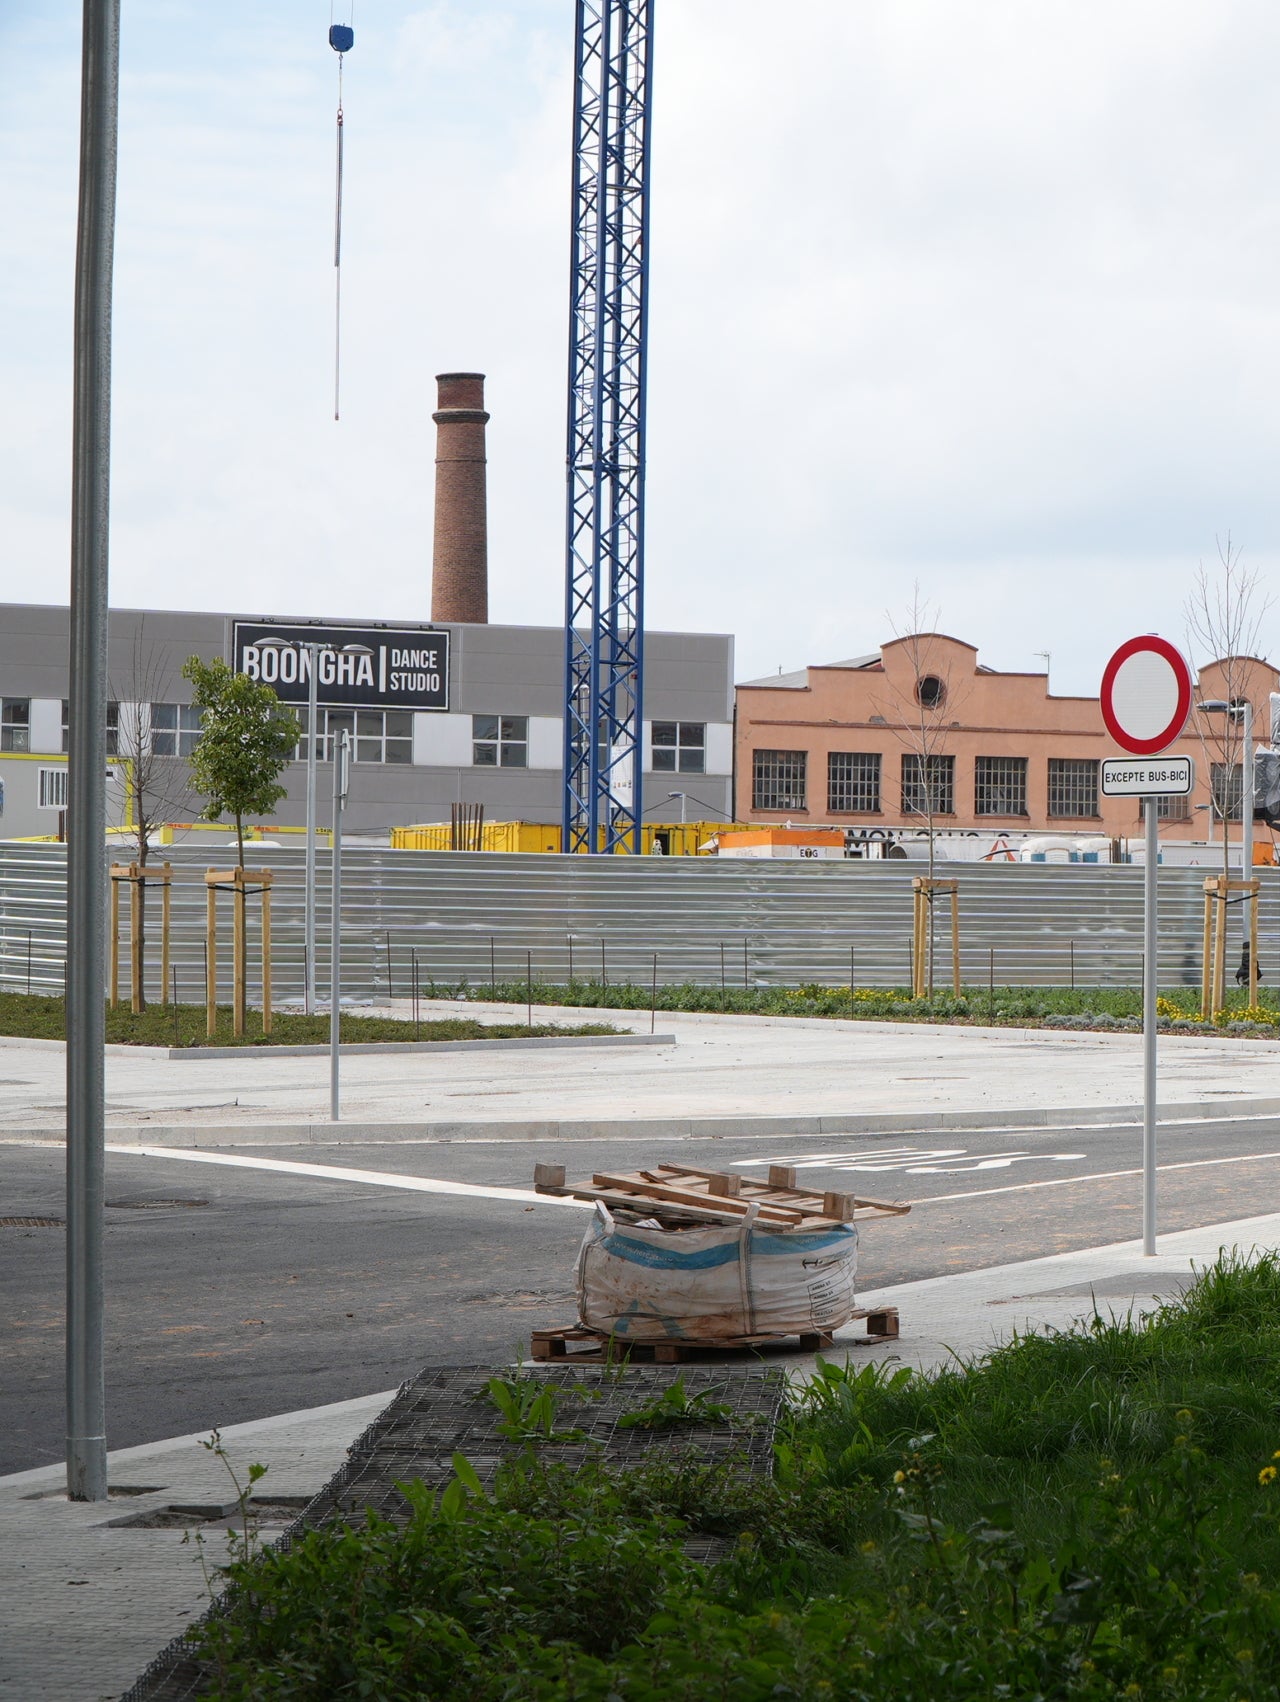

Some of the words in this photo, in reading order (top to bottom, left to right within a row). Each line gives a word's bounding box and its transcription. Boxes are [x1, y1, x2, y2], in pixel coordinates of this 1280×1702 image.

[243, 645, 375, 687] BOONGHA
[391, 648, 438, 669] DANCE
[390, 672, 440, 692] STUDIO
[1105, 772, 1145, 783] EXCEPTE
[1148, 770, 1187, 782] BUS-BICI
